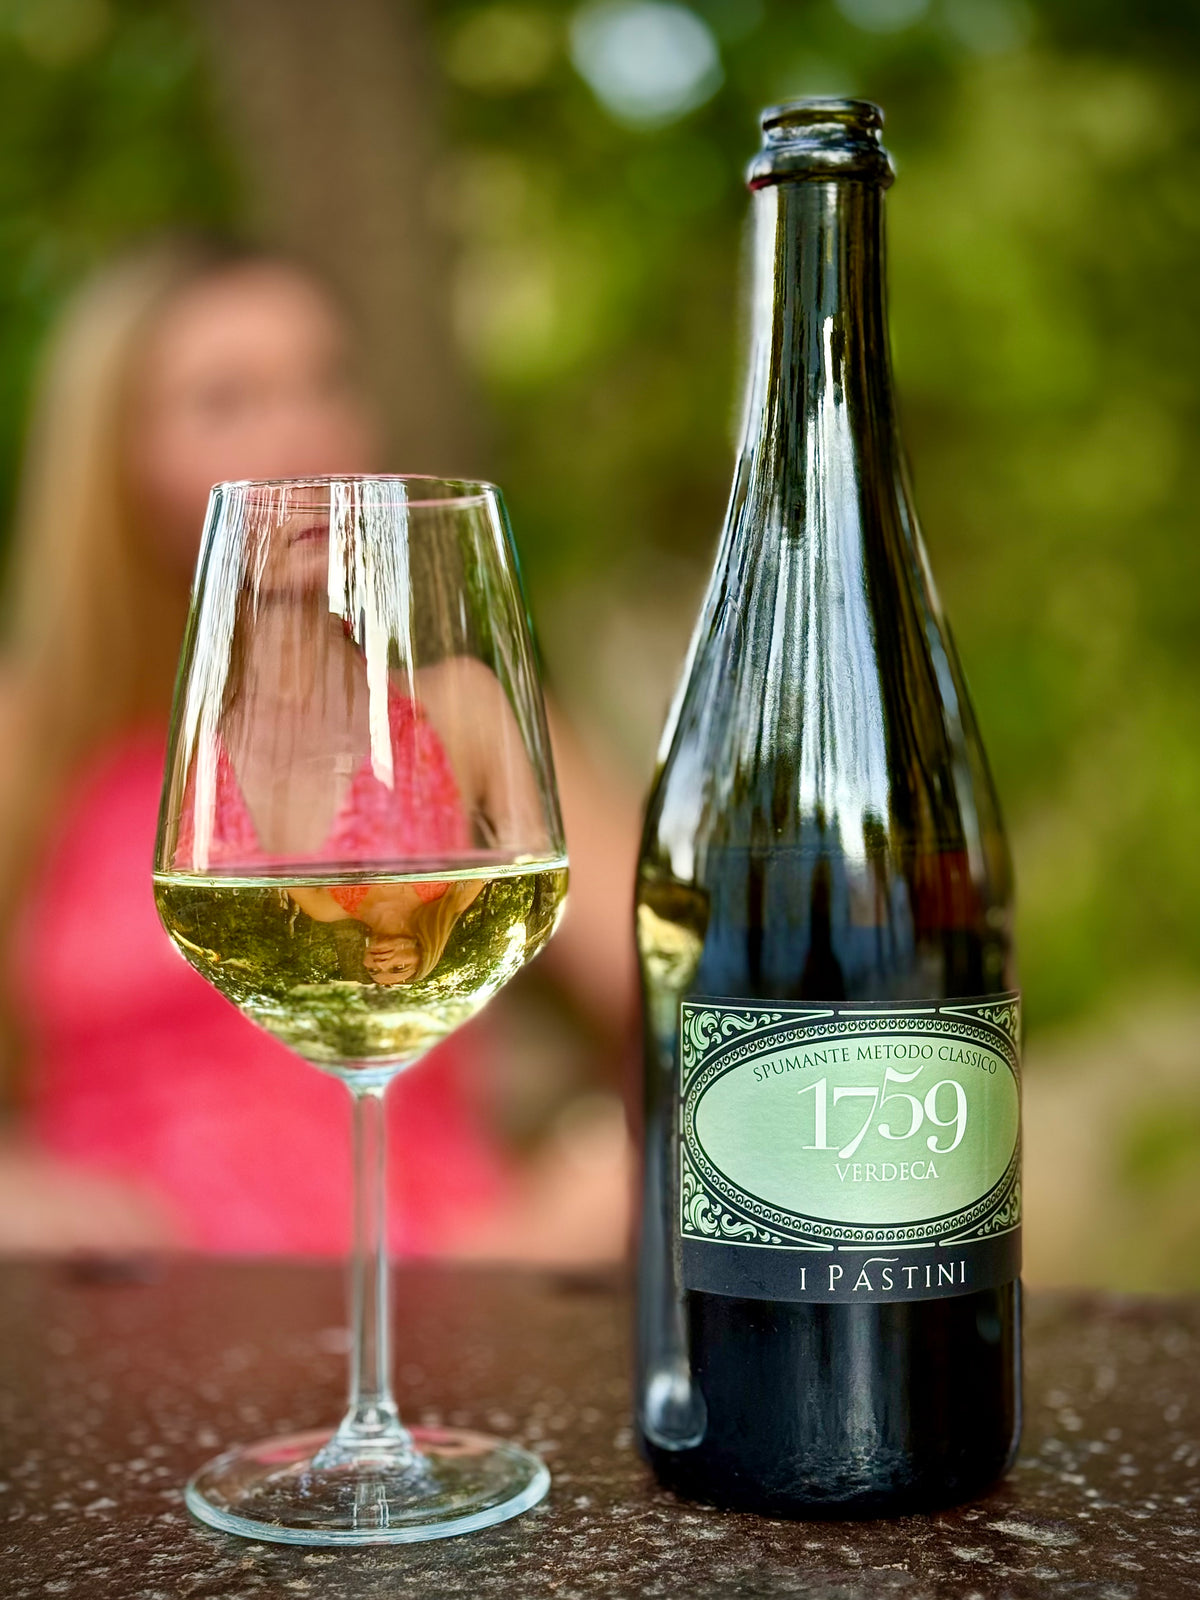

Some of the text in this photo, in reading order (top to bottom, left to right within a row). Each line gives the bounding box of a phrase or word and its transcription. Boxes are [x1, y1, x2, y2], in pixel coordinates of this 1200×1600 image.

[753, 1044, 998, 1082] SPUMANTE METODO CLASSICO
[797, 1065, 968, 1159] 1759
[833, 1160, 940, 1182] VERDECA
[799, 1257, 966, 1292] I PASTINI
